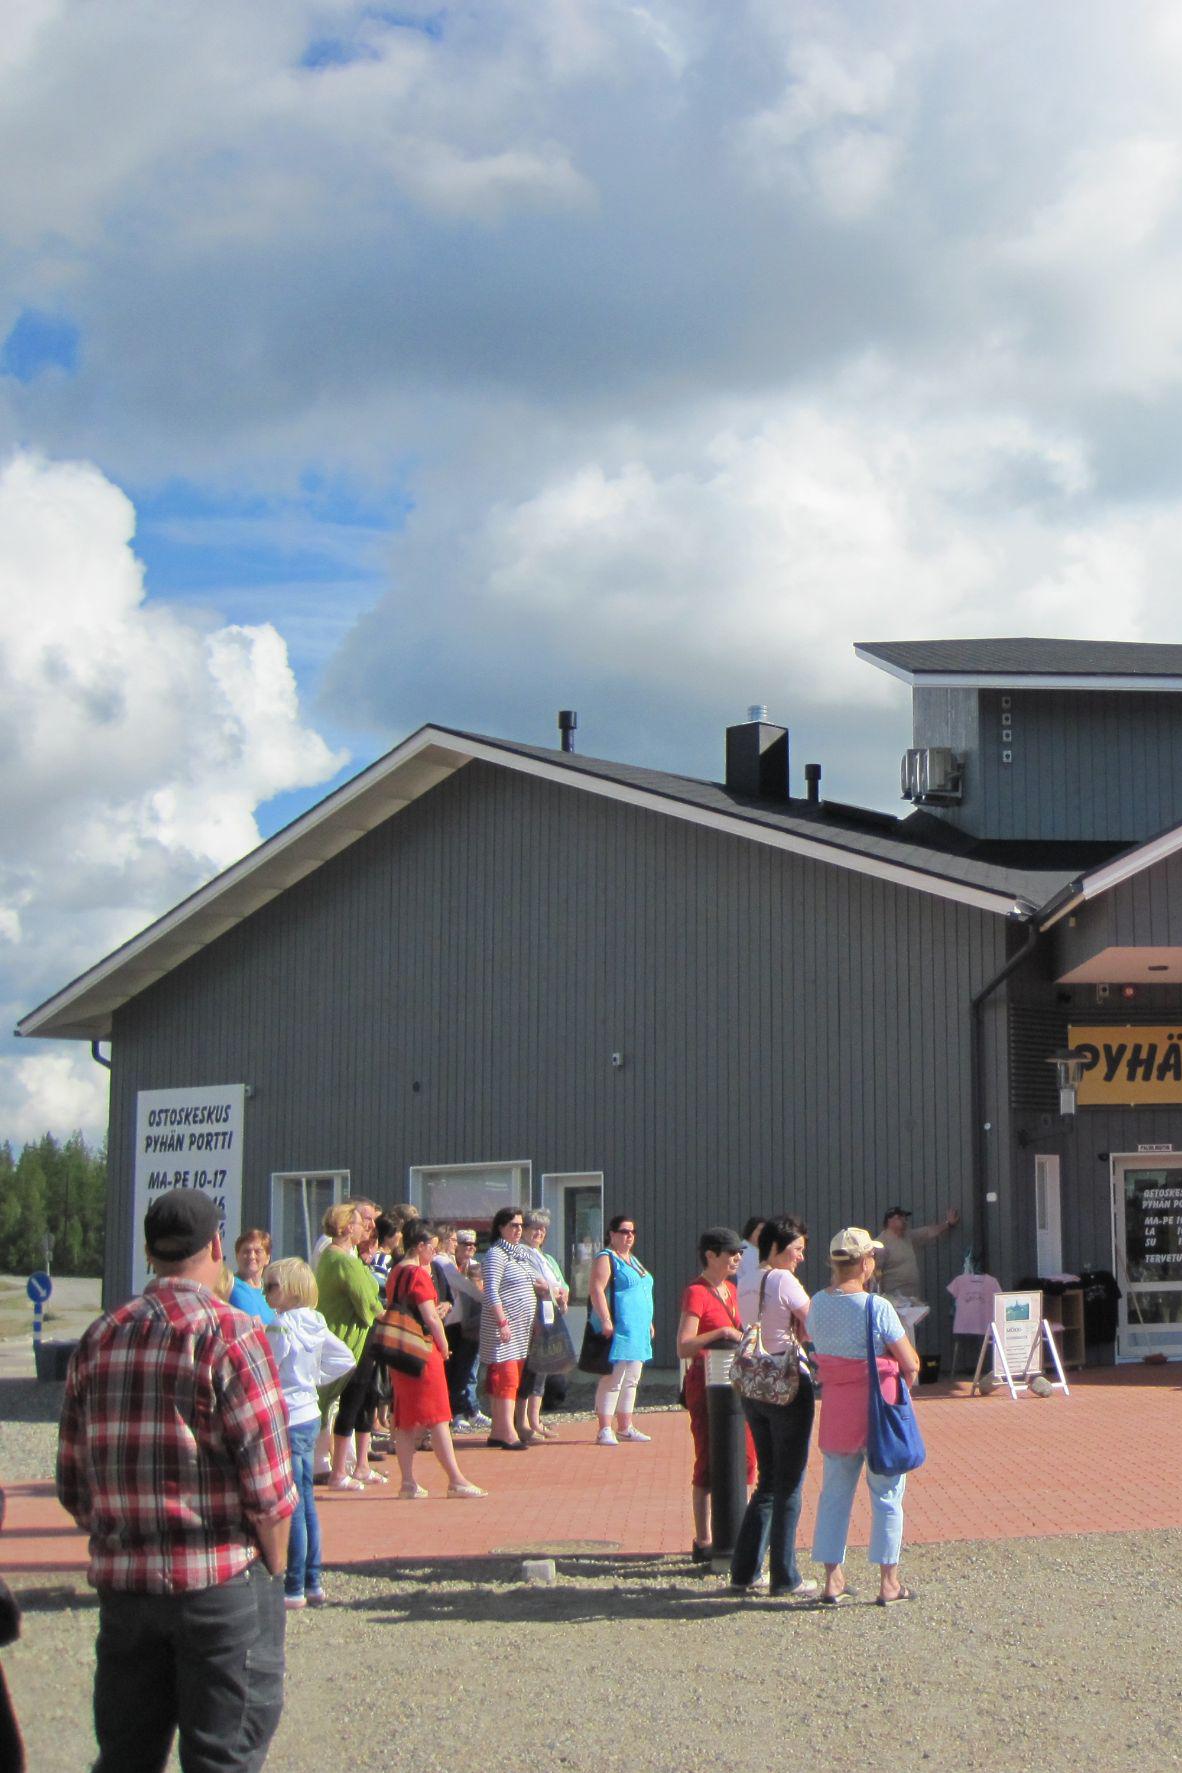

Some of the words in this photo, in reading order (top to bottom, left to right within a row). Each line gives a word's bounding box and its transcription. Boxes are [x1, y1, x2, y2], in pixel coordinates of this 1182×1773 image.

[148, 1104, 231, 1127] OSTOSKESKUS
[145, 1130, 184, 1153] PYHÄN
[188, 1131, 233, 1151] PORTTI
[148, 1171, 190, 1189] MA-PE
[193, 1170, 227, 1188] 10-17
[1144, 1216, 1174, 1225] MA-PE
[1145, 1227, 1155, 1236] LA
[1145, 1238, 1157, 1247] SU
